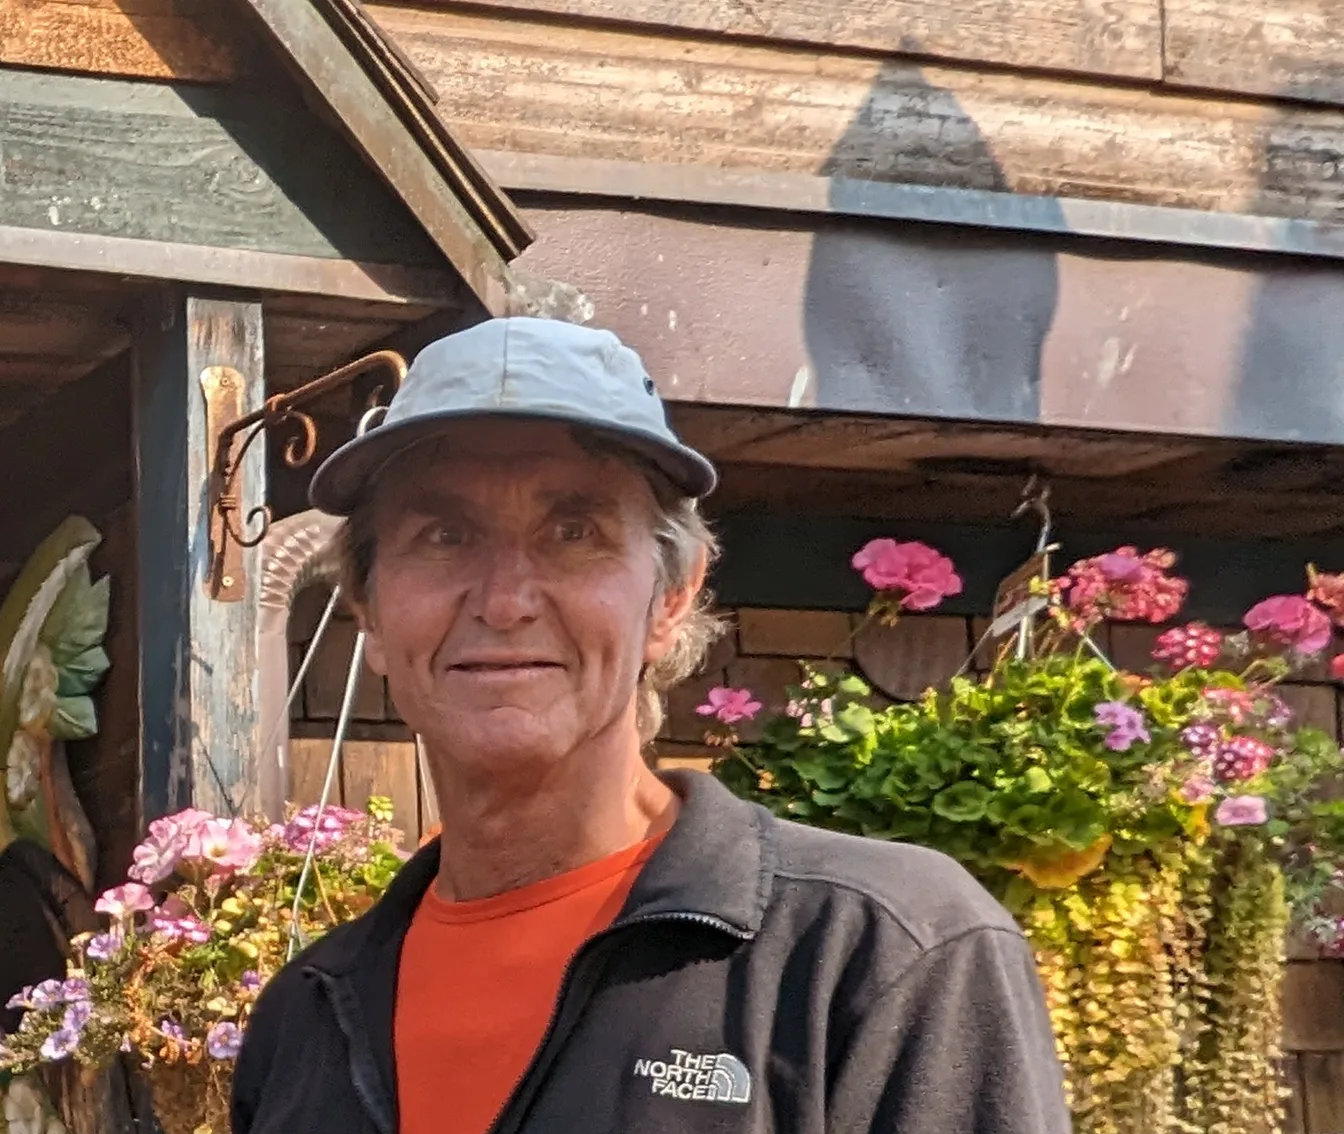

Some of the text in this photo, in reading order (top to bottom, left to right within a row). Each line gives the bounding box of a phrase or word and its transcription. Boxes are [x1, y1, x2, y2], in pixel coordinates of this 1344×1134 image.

[670, 1049, 717, 1069] THE
[633, 1059, 710, 1085] NORTH
[651, 1079, 709, 1100] FACE
